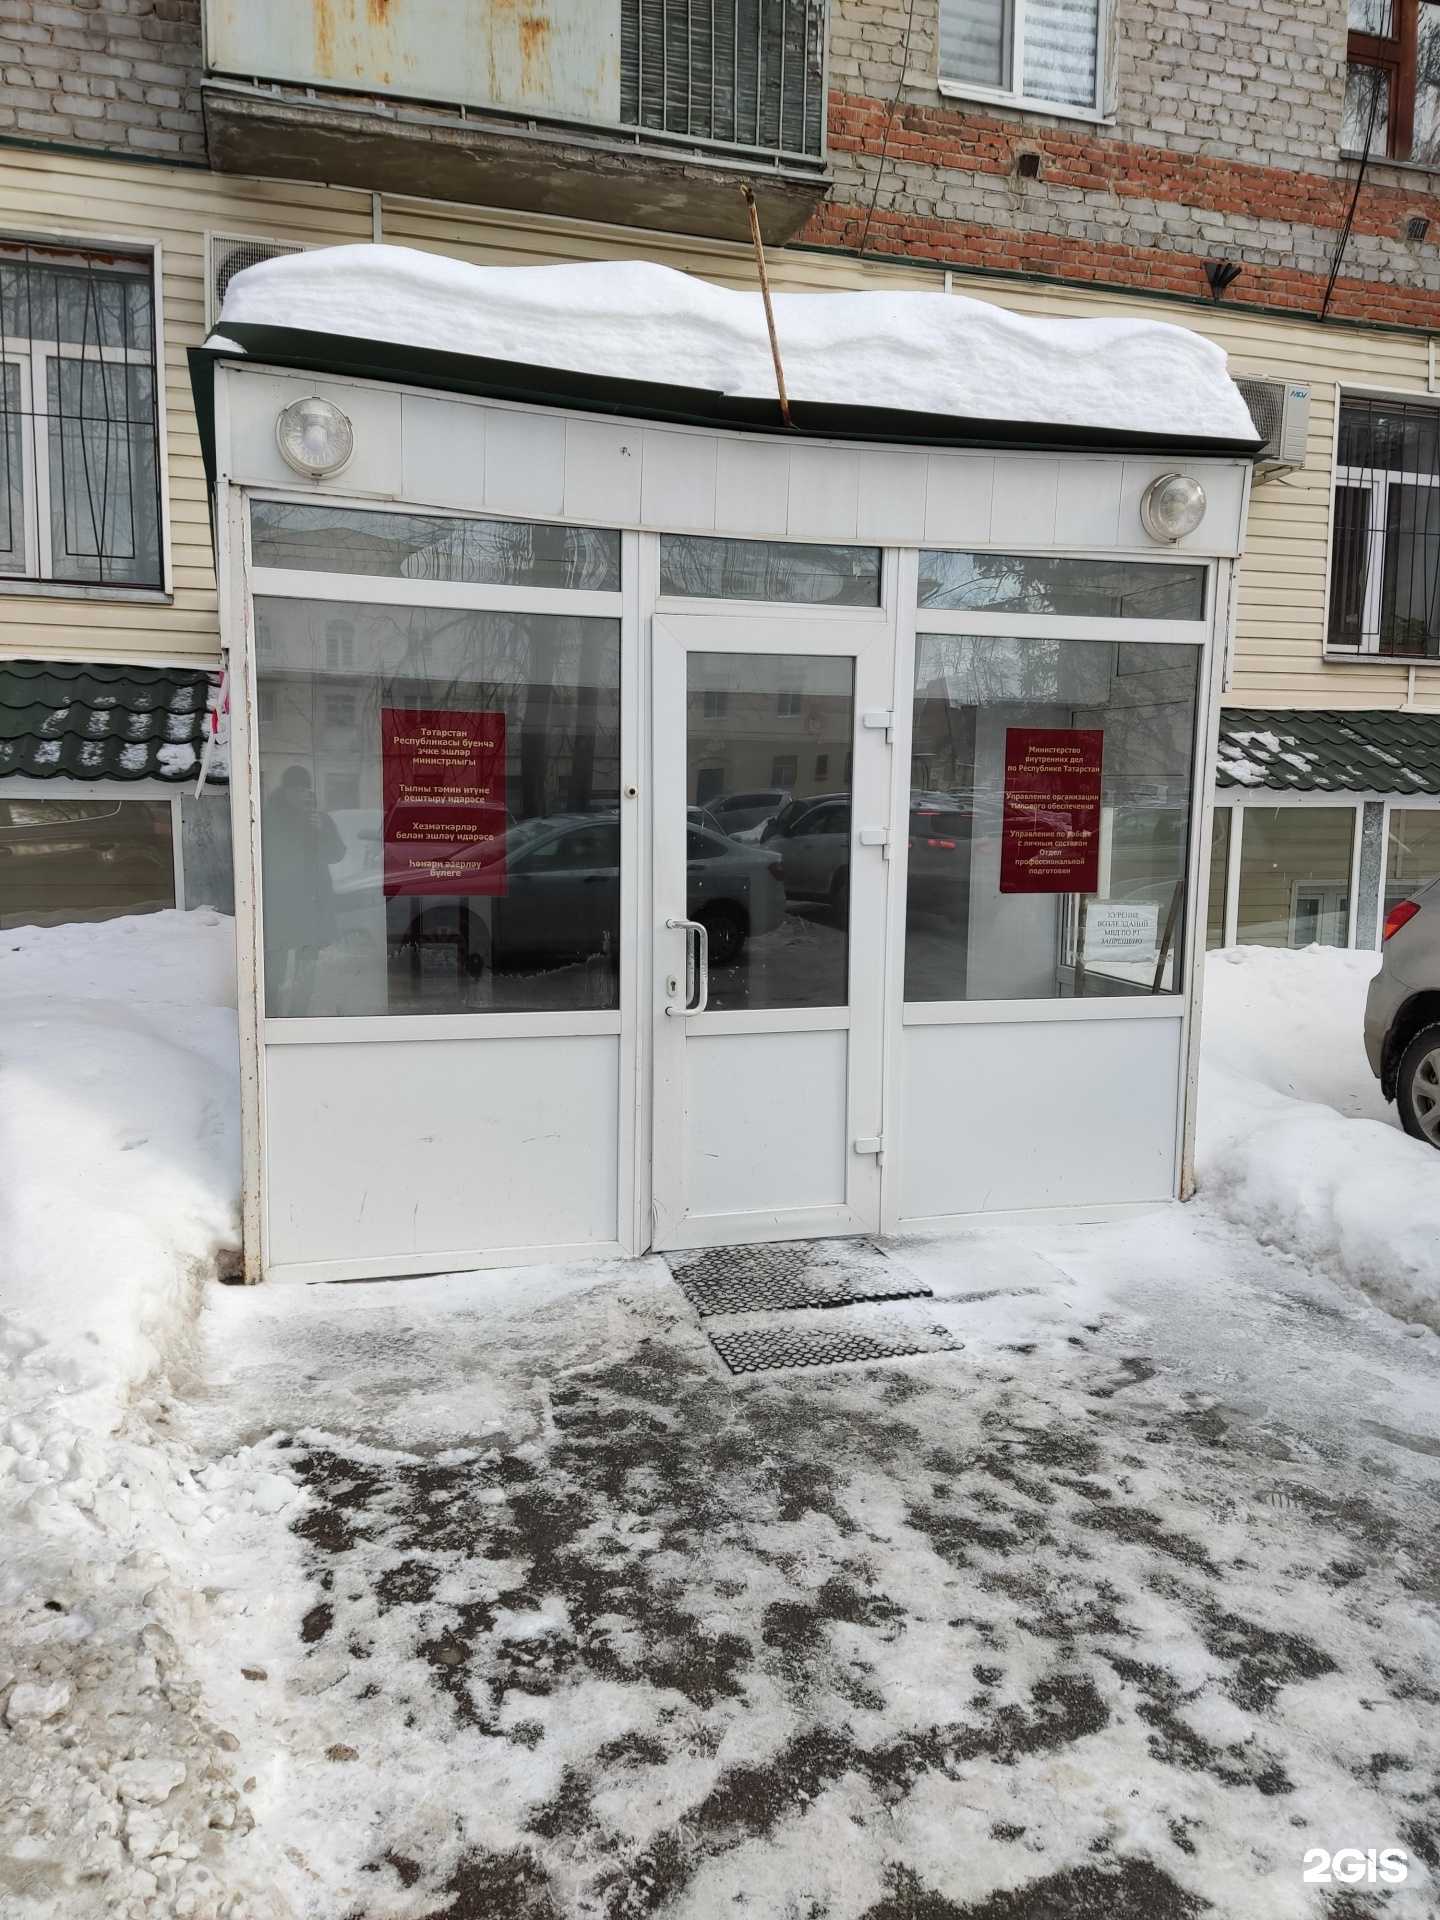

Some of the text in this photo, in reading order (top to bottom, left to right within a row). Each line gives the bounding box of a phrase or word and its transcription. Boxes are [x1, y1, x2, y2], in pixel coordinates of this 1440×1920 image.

[393, 737, 494, 748] Республикасы буенча
[1029, 746, 1080, 754] Министерство
[413, 758, 476, 766] министрлыгы
[1019, 764, 1061, 773] Республике
[1064, 766, 1100, 774] Татарстан
[400, 784, 431, 792] Тылны
[1007, 792, 1050, 800] Управление
[1010, 830, 1054, 838] Управление
[1015, 858, 1085, 866] профессиональной
